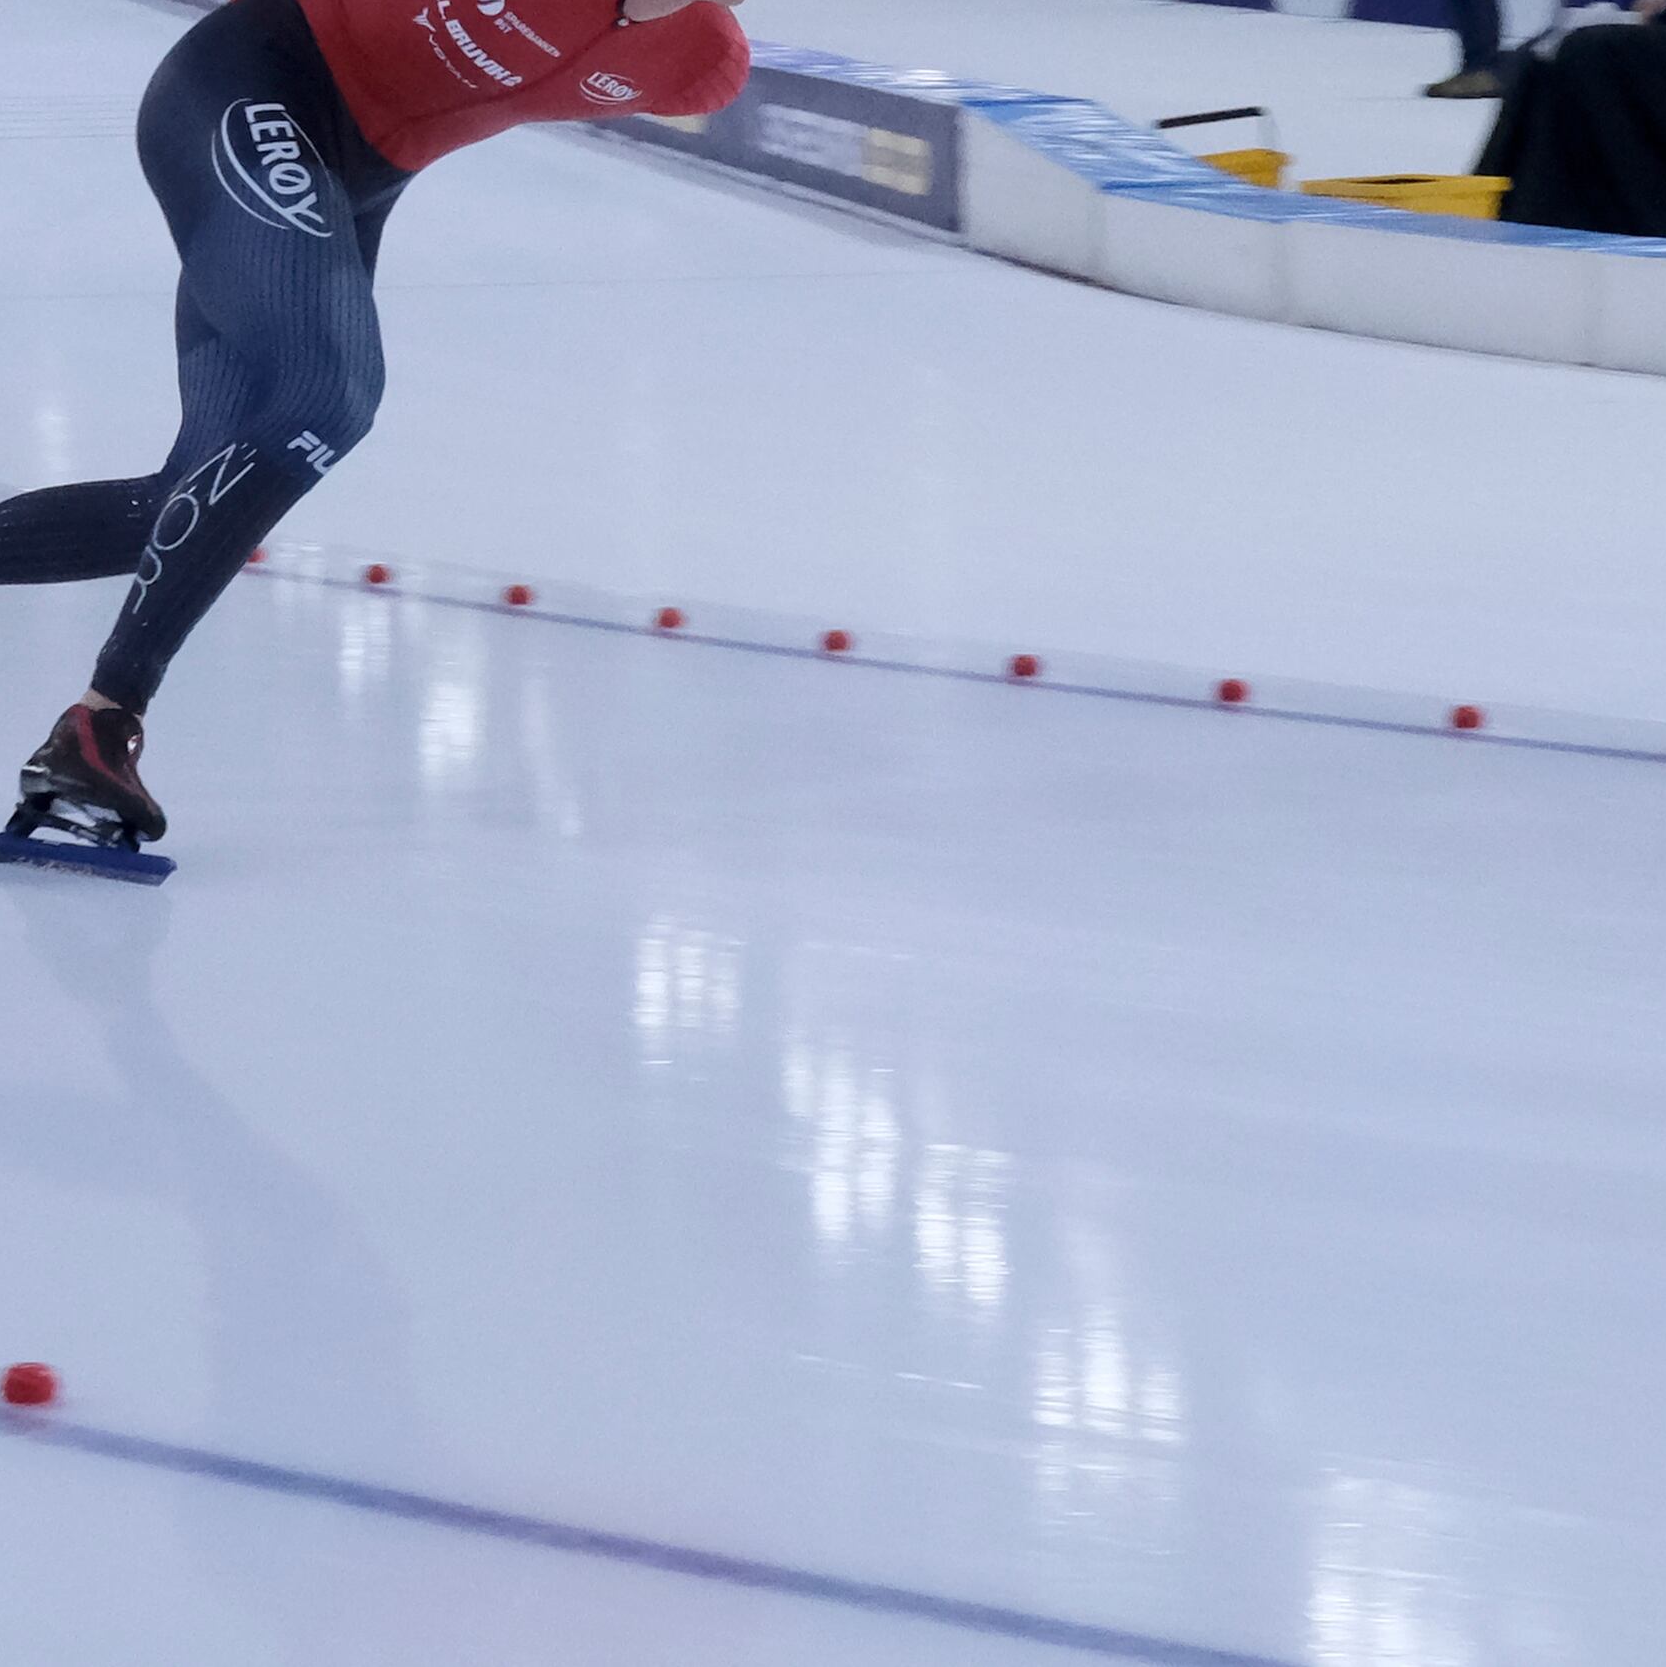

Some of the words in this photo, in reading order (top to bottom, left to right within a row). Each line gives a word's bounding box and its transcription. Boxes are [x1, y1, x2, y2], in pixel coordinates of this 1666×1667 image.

[586, 71, 639, 101] LERØY
[244, 103, 332, 237] LERØY
[286, 430, 336, 474] FIL
